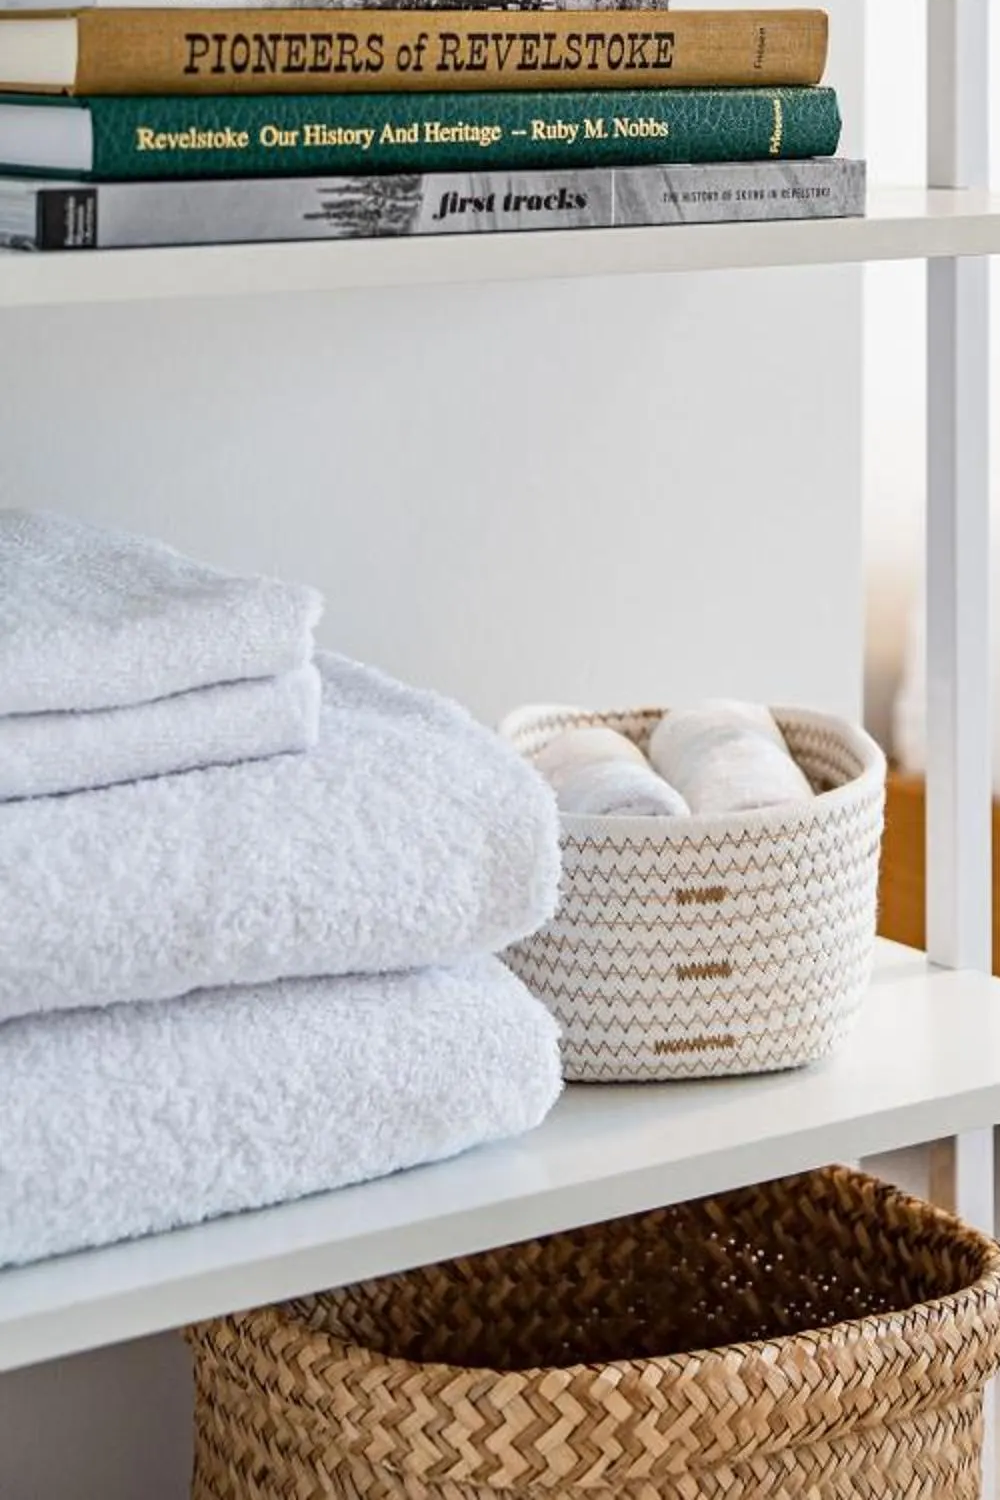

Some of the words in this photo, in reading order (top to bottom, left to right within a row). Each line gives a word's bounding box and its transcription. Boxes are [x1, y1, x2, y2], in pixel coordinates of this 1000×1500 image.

[184, 33, 385, 74] PIONEERS
[396, 32, 429, 72] of
[435, 31, 676, 71] REVELSTOKE
[135, 126, 249, 151] Revelstoke
[259, 124, 299, 147] Our
[303, 122, 375, 149] History
[379, 122, 419, 144] And
[423, 121, 502, 147] Heritage
[531, 119, 579, 144] Ruby
[583, 118, 609, 139] M.
[613, 116, 669, 139] Nobbs
[432, 191, 496, 220] first
[503, 187, 590, 212] tracks
